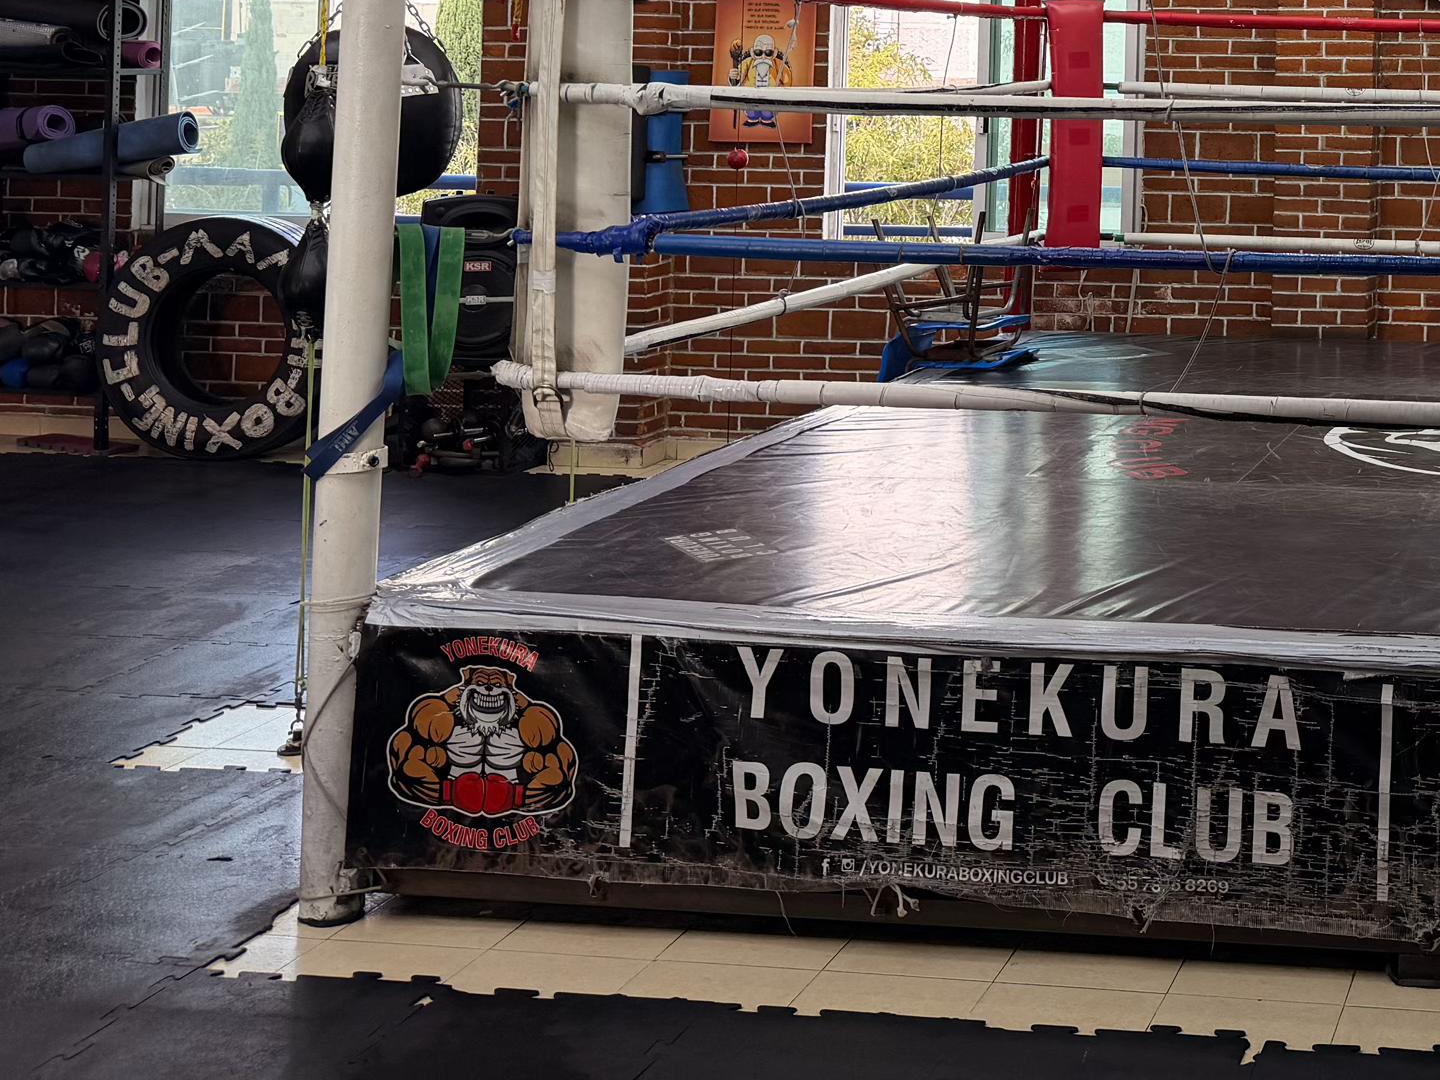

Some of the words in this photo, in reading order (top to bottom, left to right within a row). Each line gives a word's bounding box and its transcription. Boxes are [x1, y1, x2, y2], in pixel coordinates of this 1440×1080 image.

[466, 262, 490, 271] KSR
[440, 636, 539, 674] YONEKURA
[737, 646, 1302, 751] YONEKURA
[420, 809, 489, 850] BOXING
[494, 816, 541, 849] CLUB
[733, 761, 1016, 851] BOXING
[1099, 778, 1295, 865] CLUB
[1185, 879, 1230, 894] 8269
